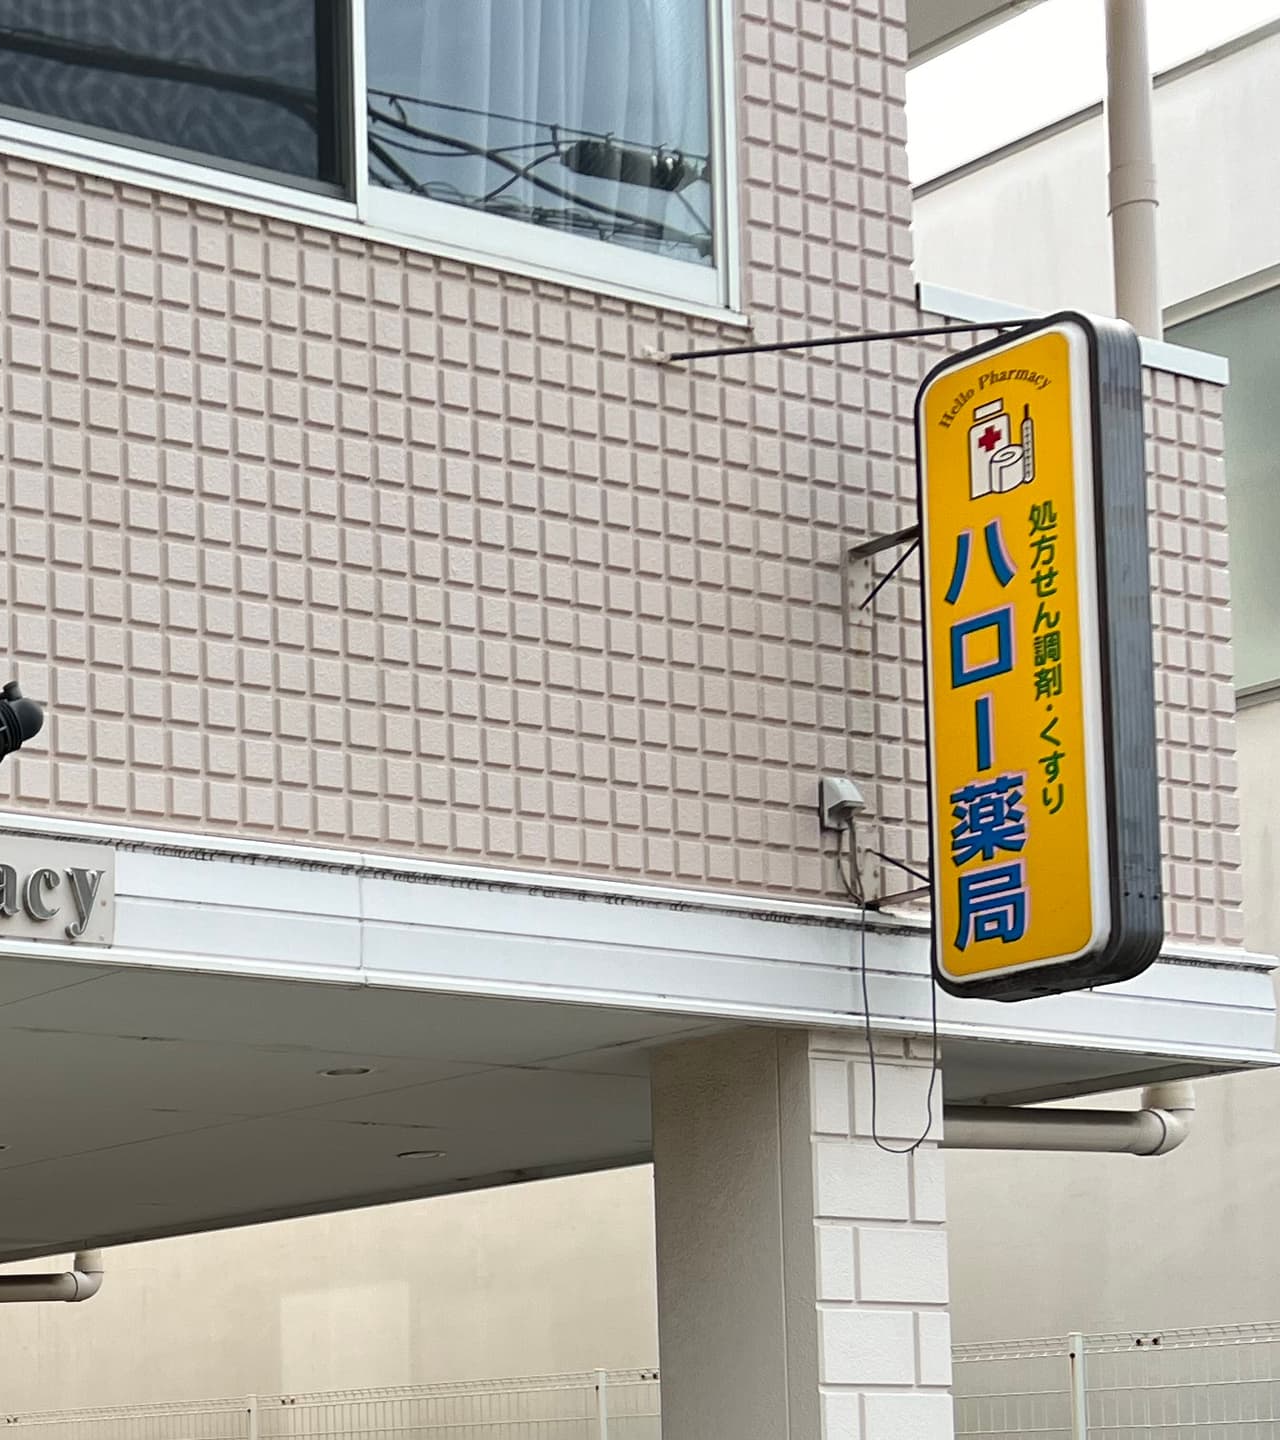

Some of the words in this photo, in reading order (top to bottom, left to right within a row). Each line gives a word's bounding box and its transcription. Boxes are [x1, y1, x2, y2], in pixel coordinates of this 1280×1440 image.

[938, 388, 975, 430] Hello
[978, 368, 1052, 391] Pharmacy
[944, 516, 1031, 952] ハロー薬局
[1028, 500, 1066, 815] 処方せん調剤・くすり
